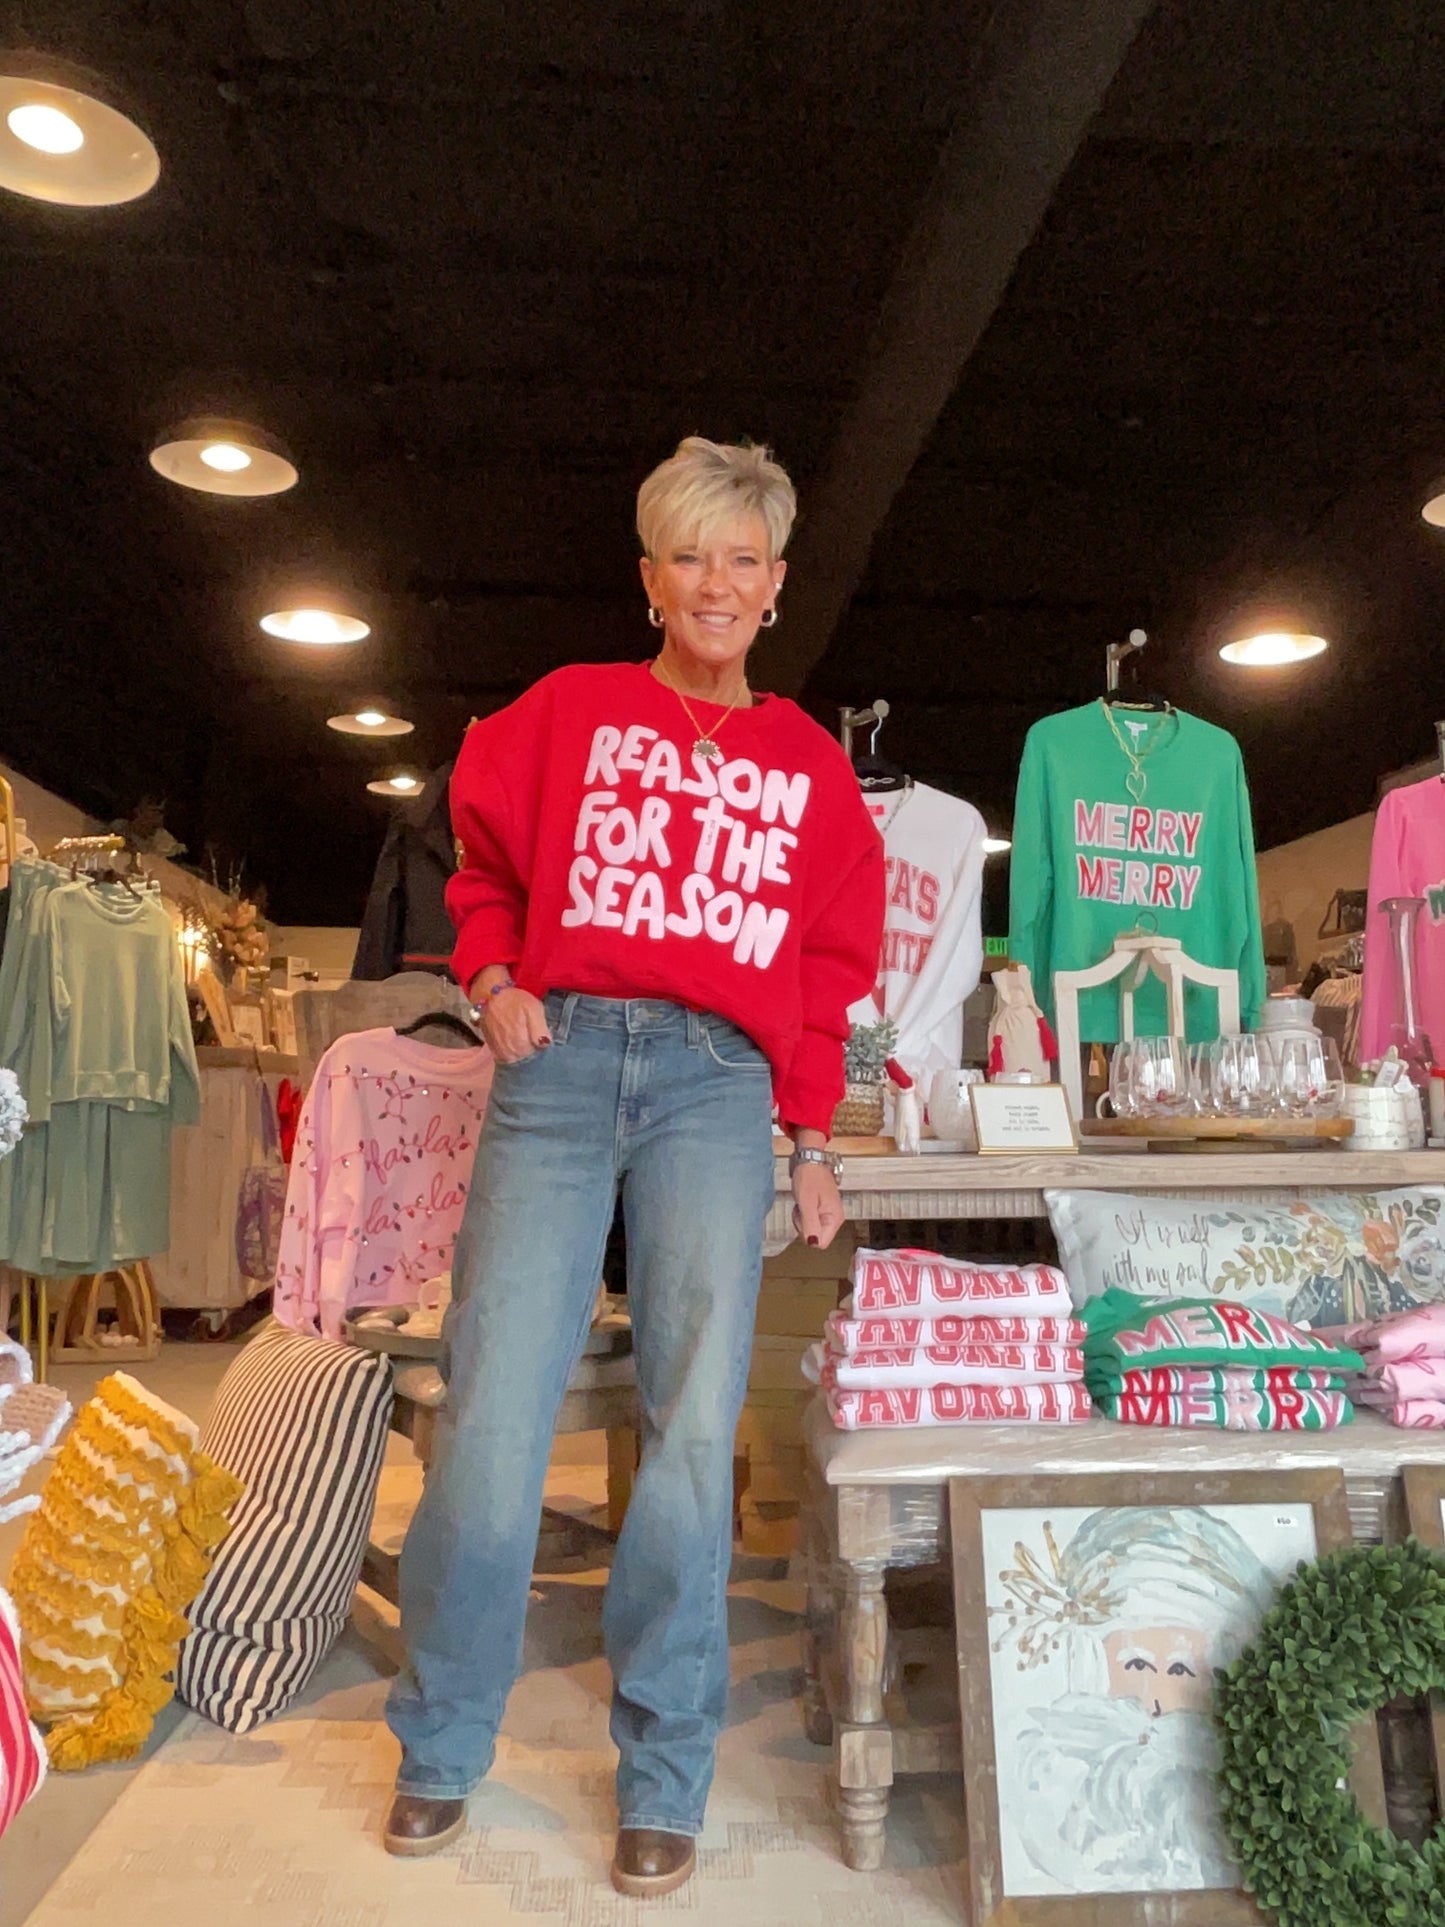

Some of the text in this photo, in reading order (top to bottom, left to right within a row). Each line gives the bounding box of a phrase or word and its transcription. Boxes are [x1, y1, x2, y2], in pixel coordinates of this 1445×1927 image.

[584, 725, 810, 828] REASON
[574, 791, 671, 868] FOR
[1075, 799, 1202, 857] MERRY
[1076, 853, 1201, 910] MERRY
[561, 855, 789, 970] SEASON
[423, 1115, 456, 1153] la
[364, 1172, 466, 1234] la la
[1115, 1209, 1211, 1250] It is well
[1102, 1247, 1213, 1296] with my soul
